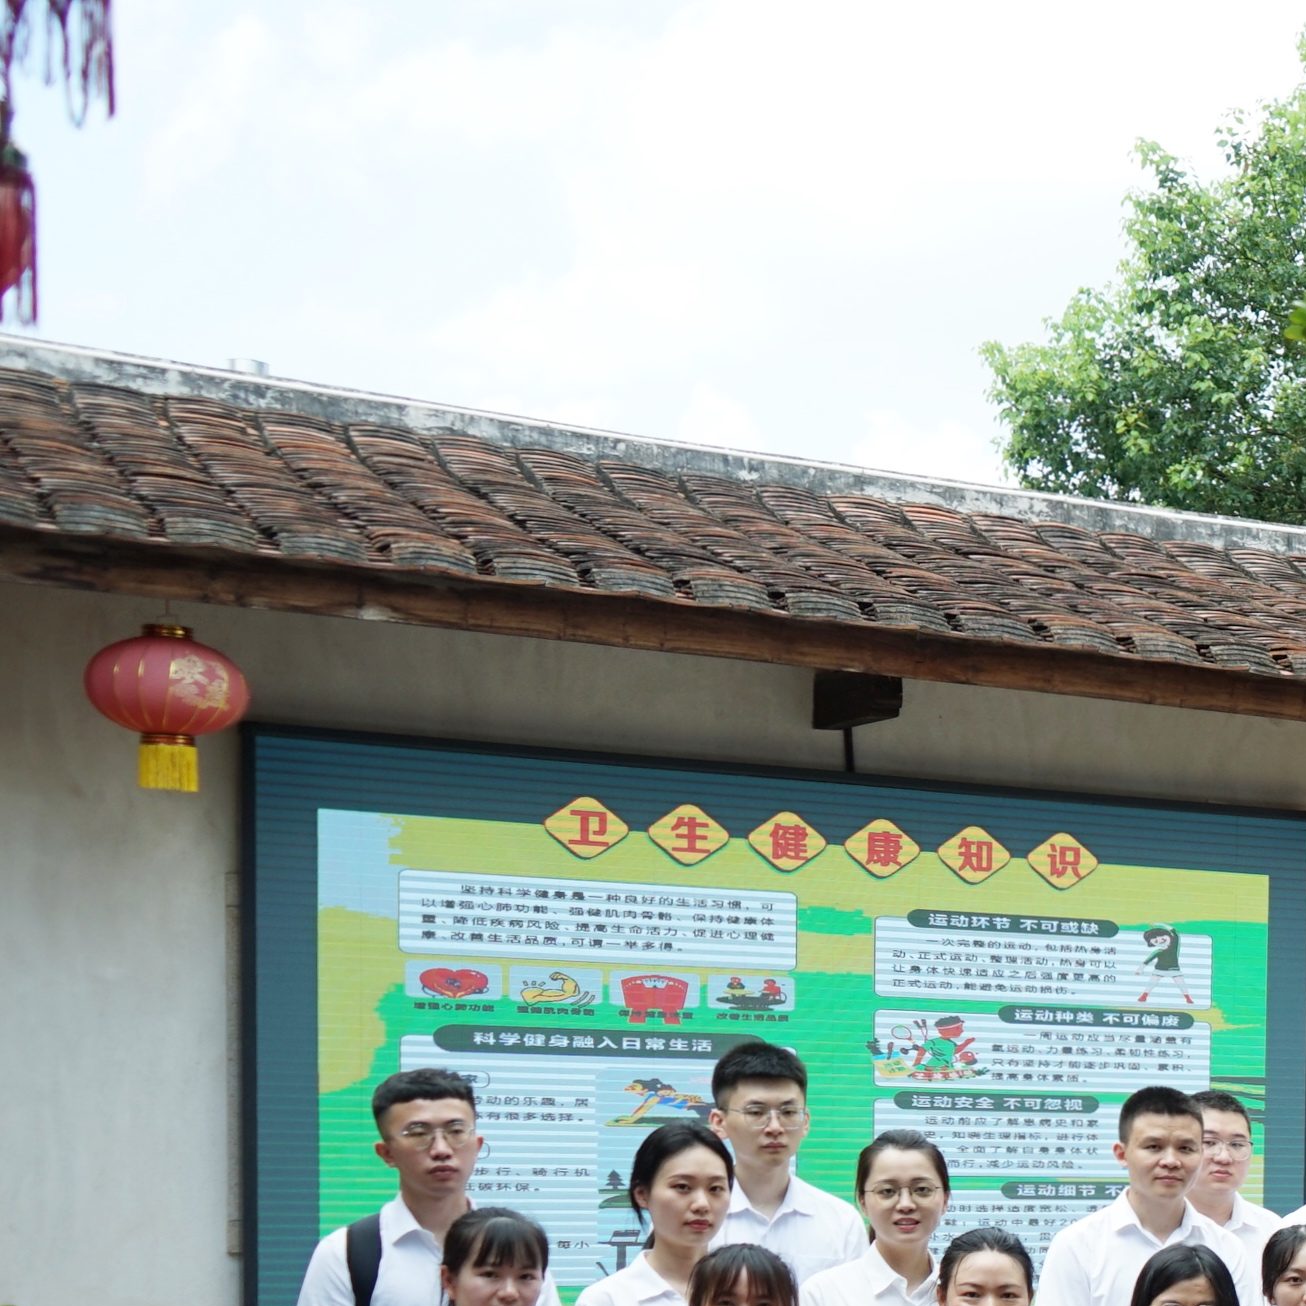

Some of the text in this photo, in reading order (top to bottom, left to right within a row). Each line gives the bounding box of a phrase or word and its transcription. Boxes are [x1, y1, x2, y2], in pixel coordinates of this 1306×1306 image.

[568, 809, 1083, 879] 卫生健康知识
[928, 913, 1100, 935] 运动环节 不可或缺
[1014, 1009, 1180, 1027] 运动种类 不可偏废
[473, 1031, 713, 1053] 科学健身融入日常生活
[911, 1095, 1084, 1111] 运动安全 不可忽视
[1017, 1184, 1096, 1197] 运动细节
